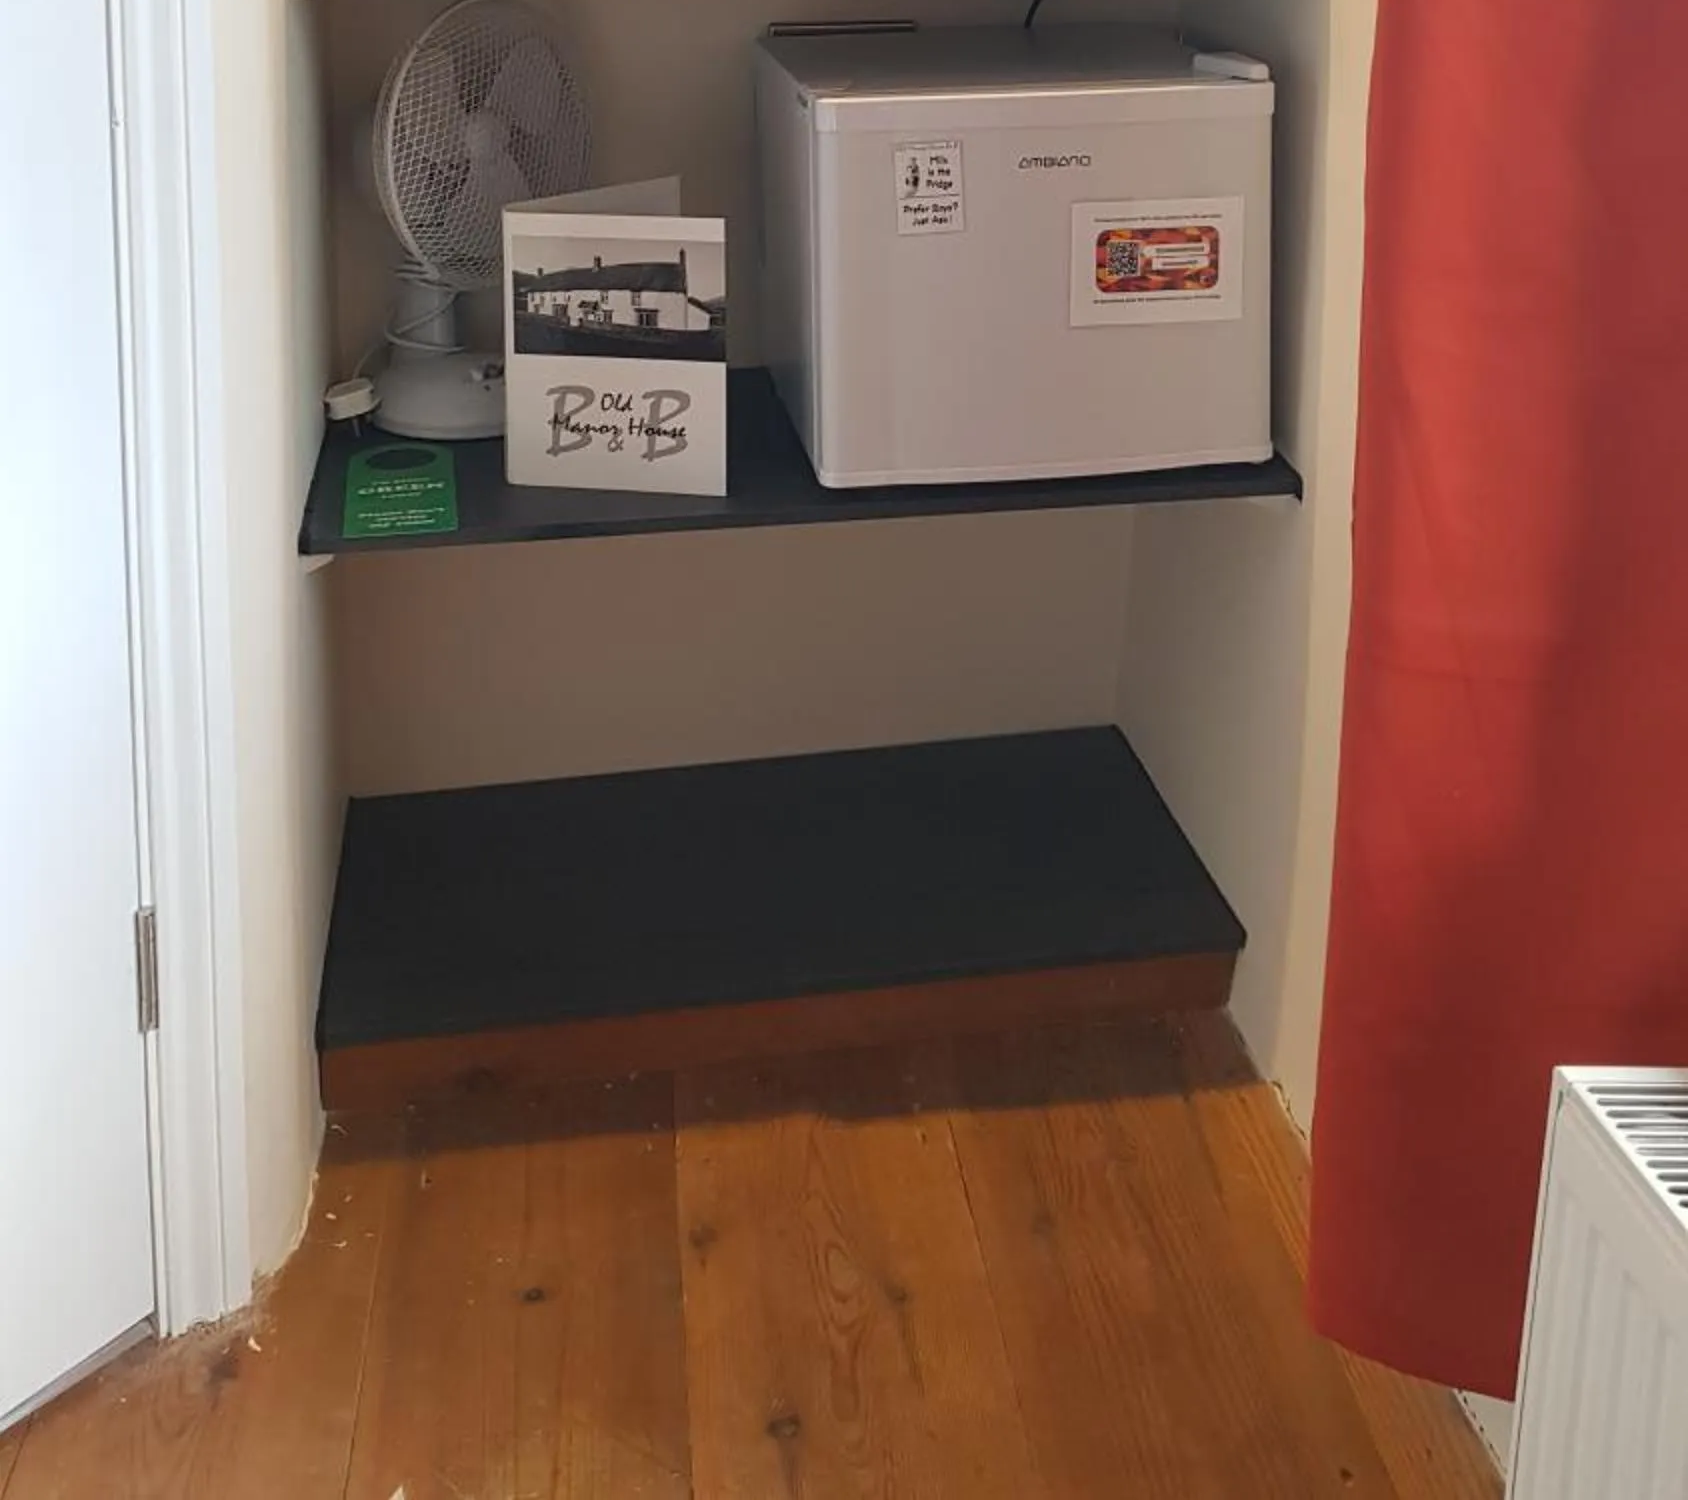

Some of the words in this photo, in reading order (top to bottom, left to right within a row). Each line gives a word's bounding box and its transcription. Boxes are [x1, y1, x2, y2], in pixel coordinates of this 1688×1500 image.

[600, 393, 633, 412] Old
[548, 414, 620, 435] Manor
[628, 416, 687, 438] House
